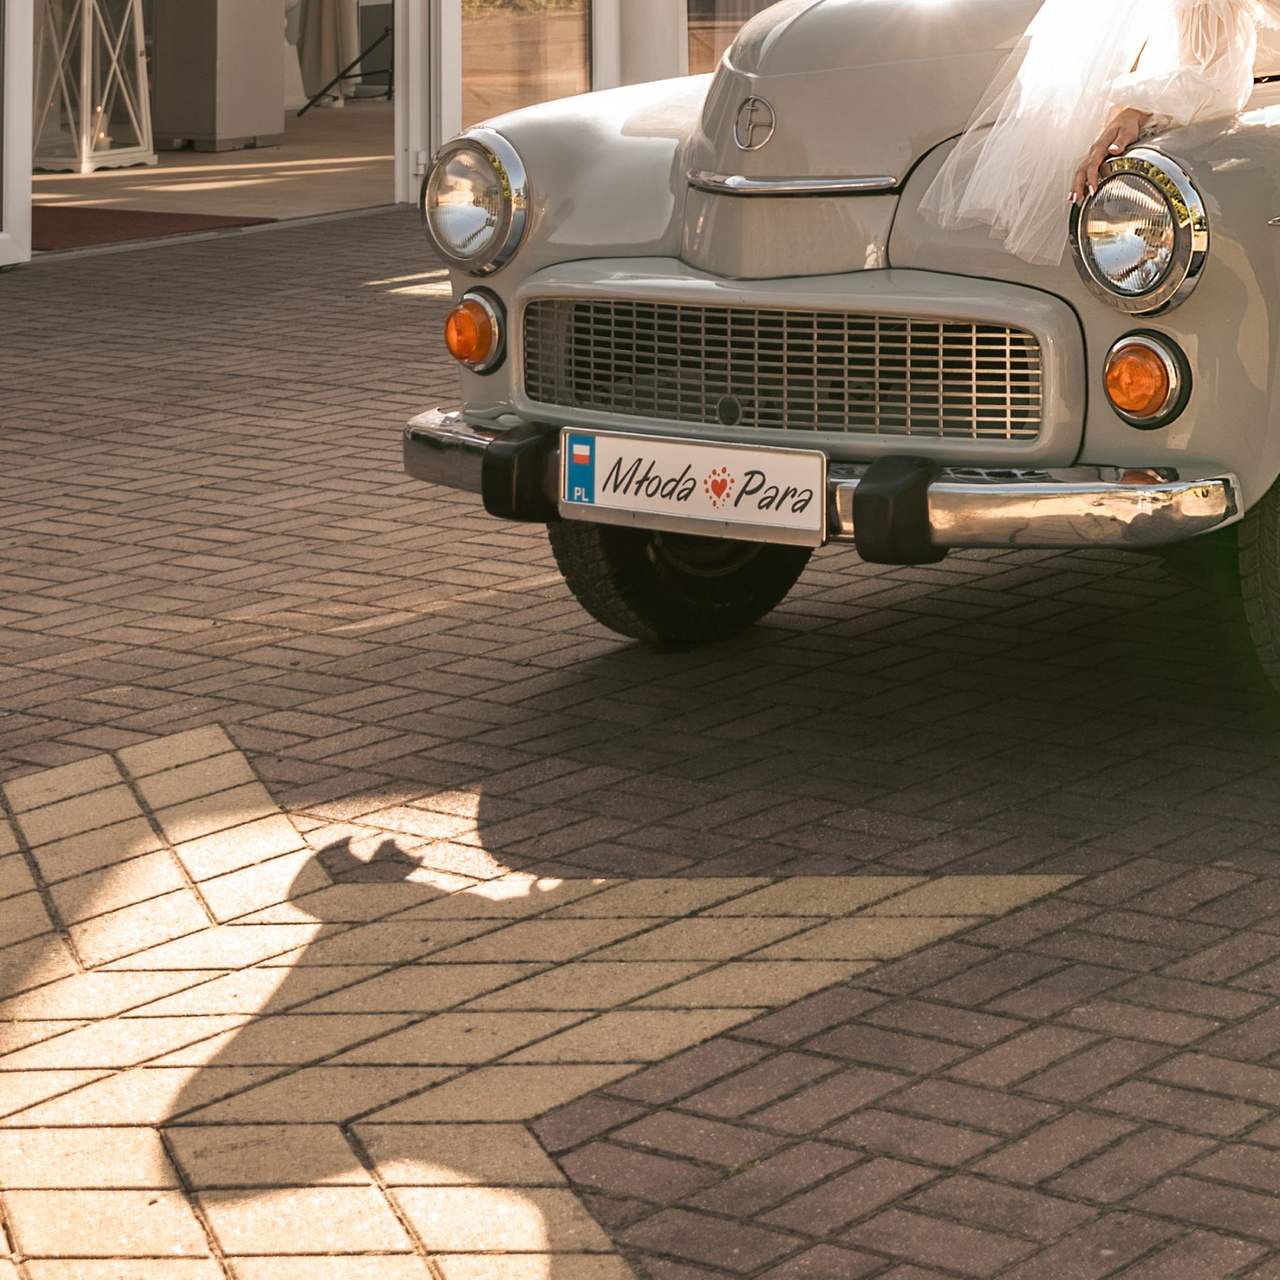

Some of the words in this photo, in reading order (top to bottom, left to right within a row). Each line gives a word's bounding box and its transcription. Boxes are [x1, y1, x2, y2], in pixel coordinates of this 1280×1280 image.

[573, 486, 589, 502] PL
[602, 456, 697, 502] Młoda
[733, 469, 814, 514] Para
